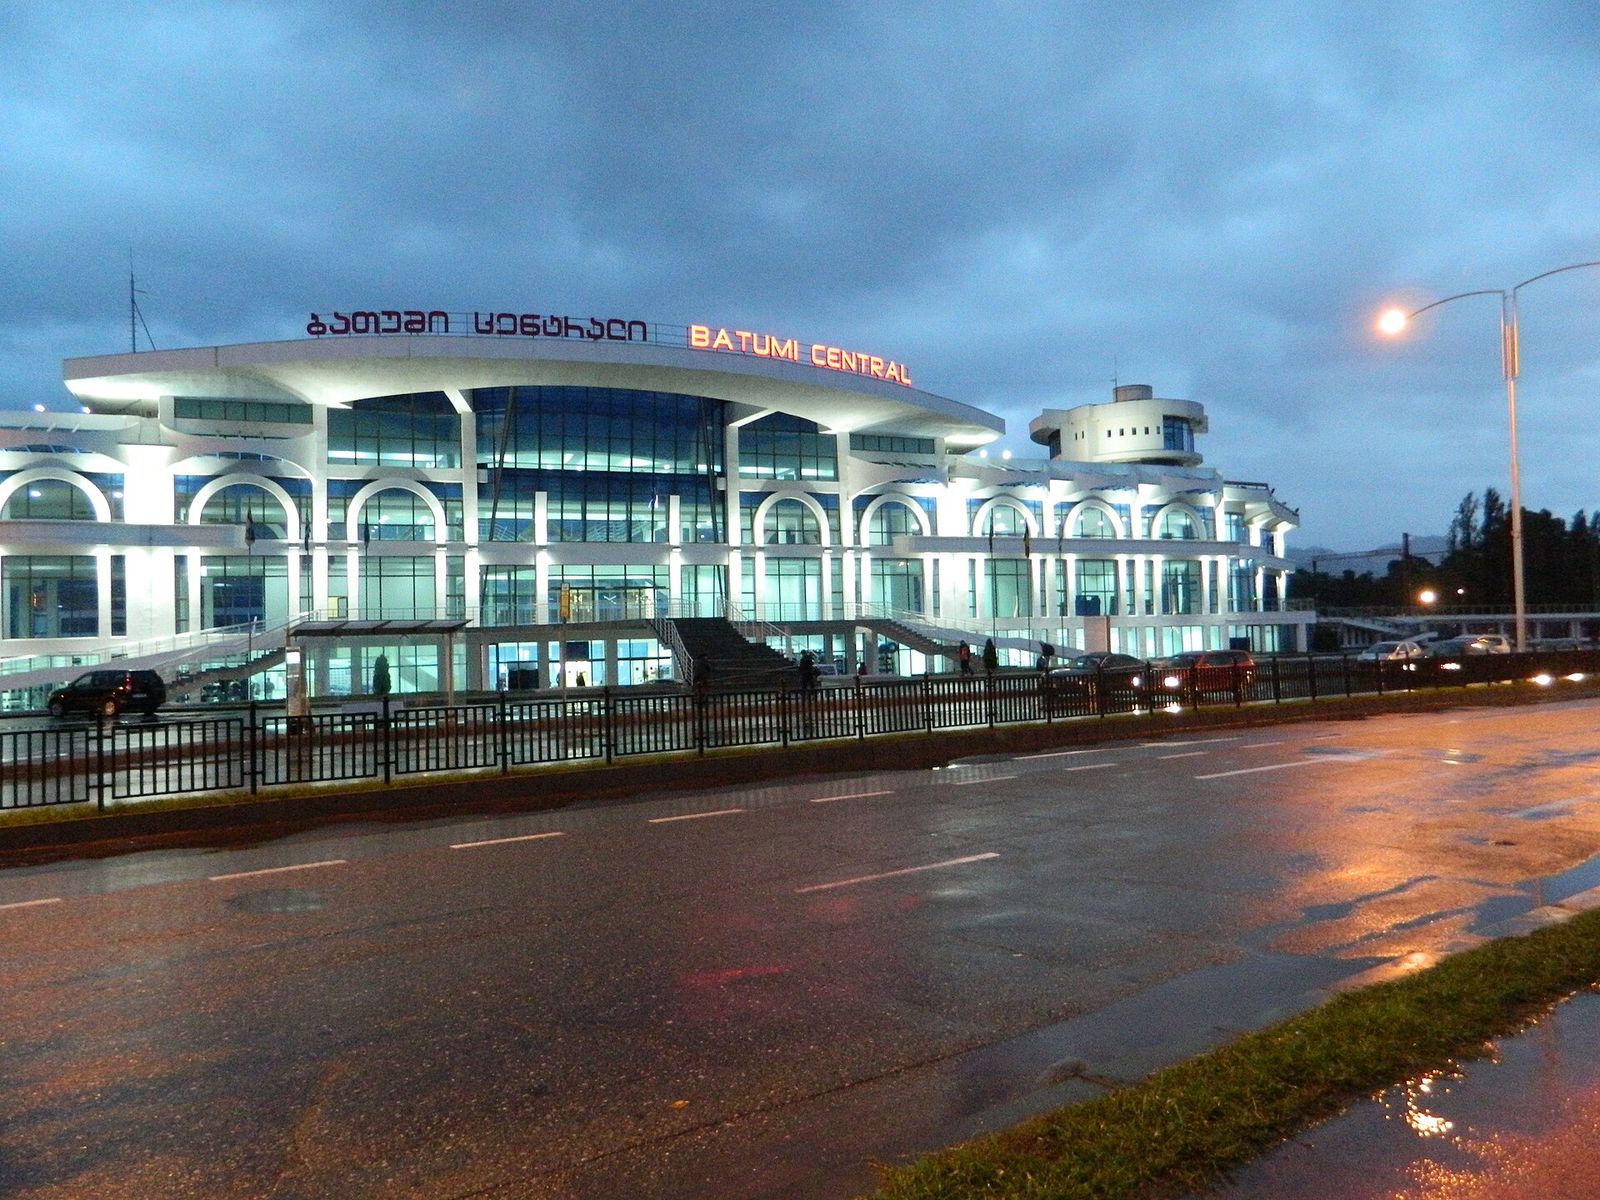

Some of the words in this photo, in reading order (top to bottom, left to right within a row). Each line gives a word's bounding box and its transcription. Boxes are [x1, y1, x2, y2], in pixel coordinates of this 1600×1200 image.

[306, 310, 449, 336] ბათუმი
[474, 311, 647, 342] ცენტრალი
[689, 324, 799, 361] BATUMI
[810, 343, 912, 385] CENTRAL
